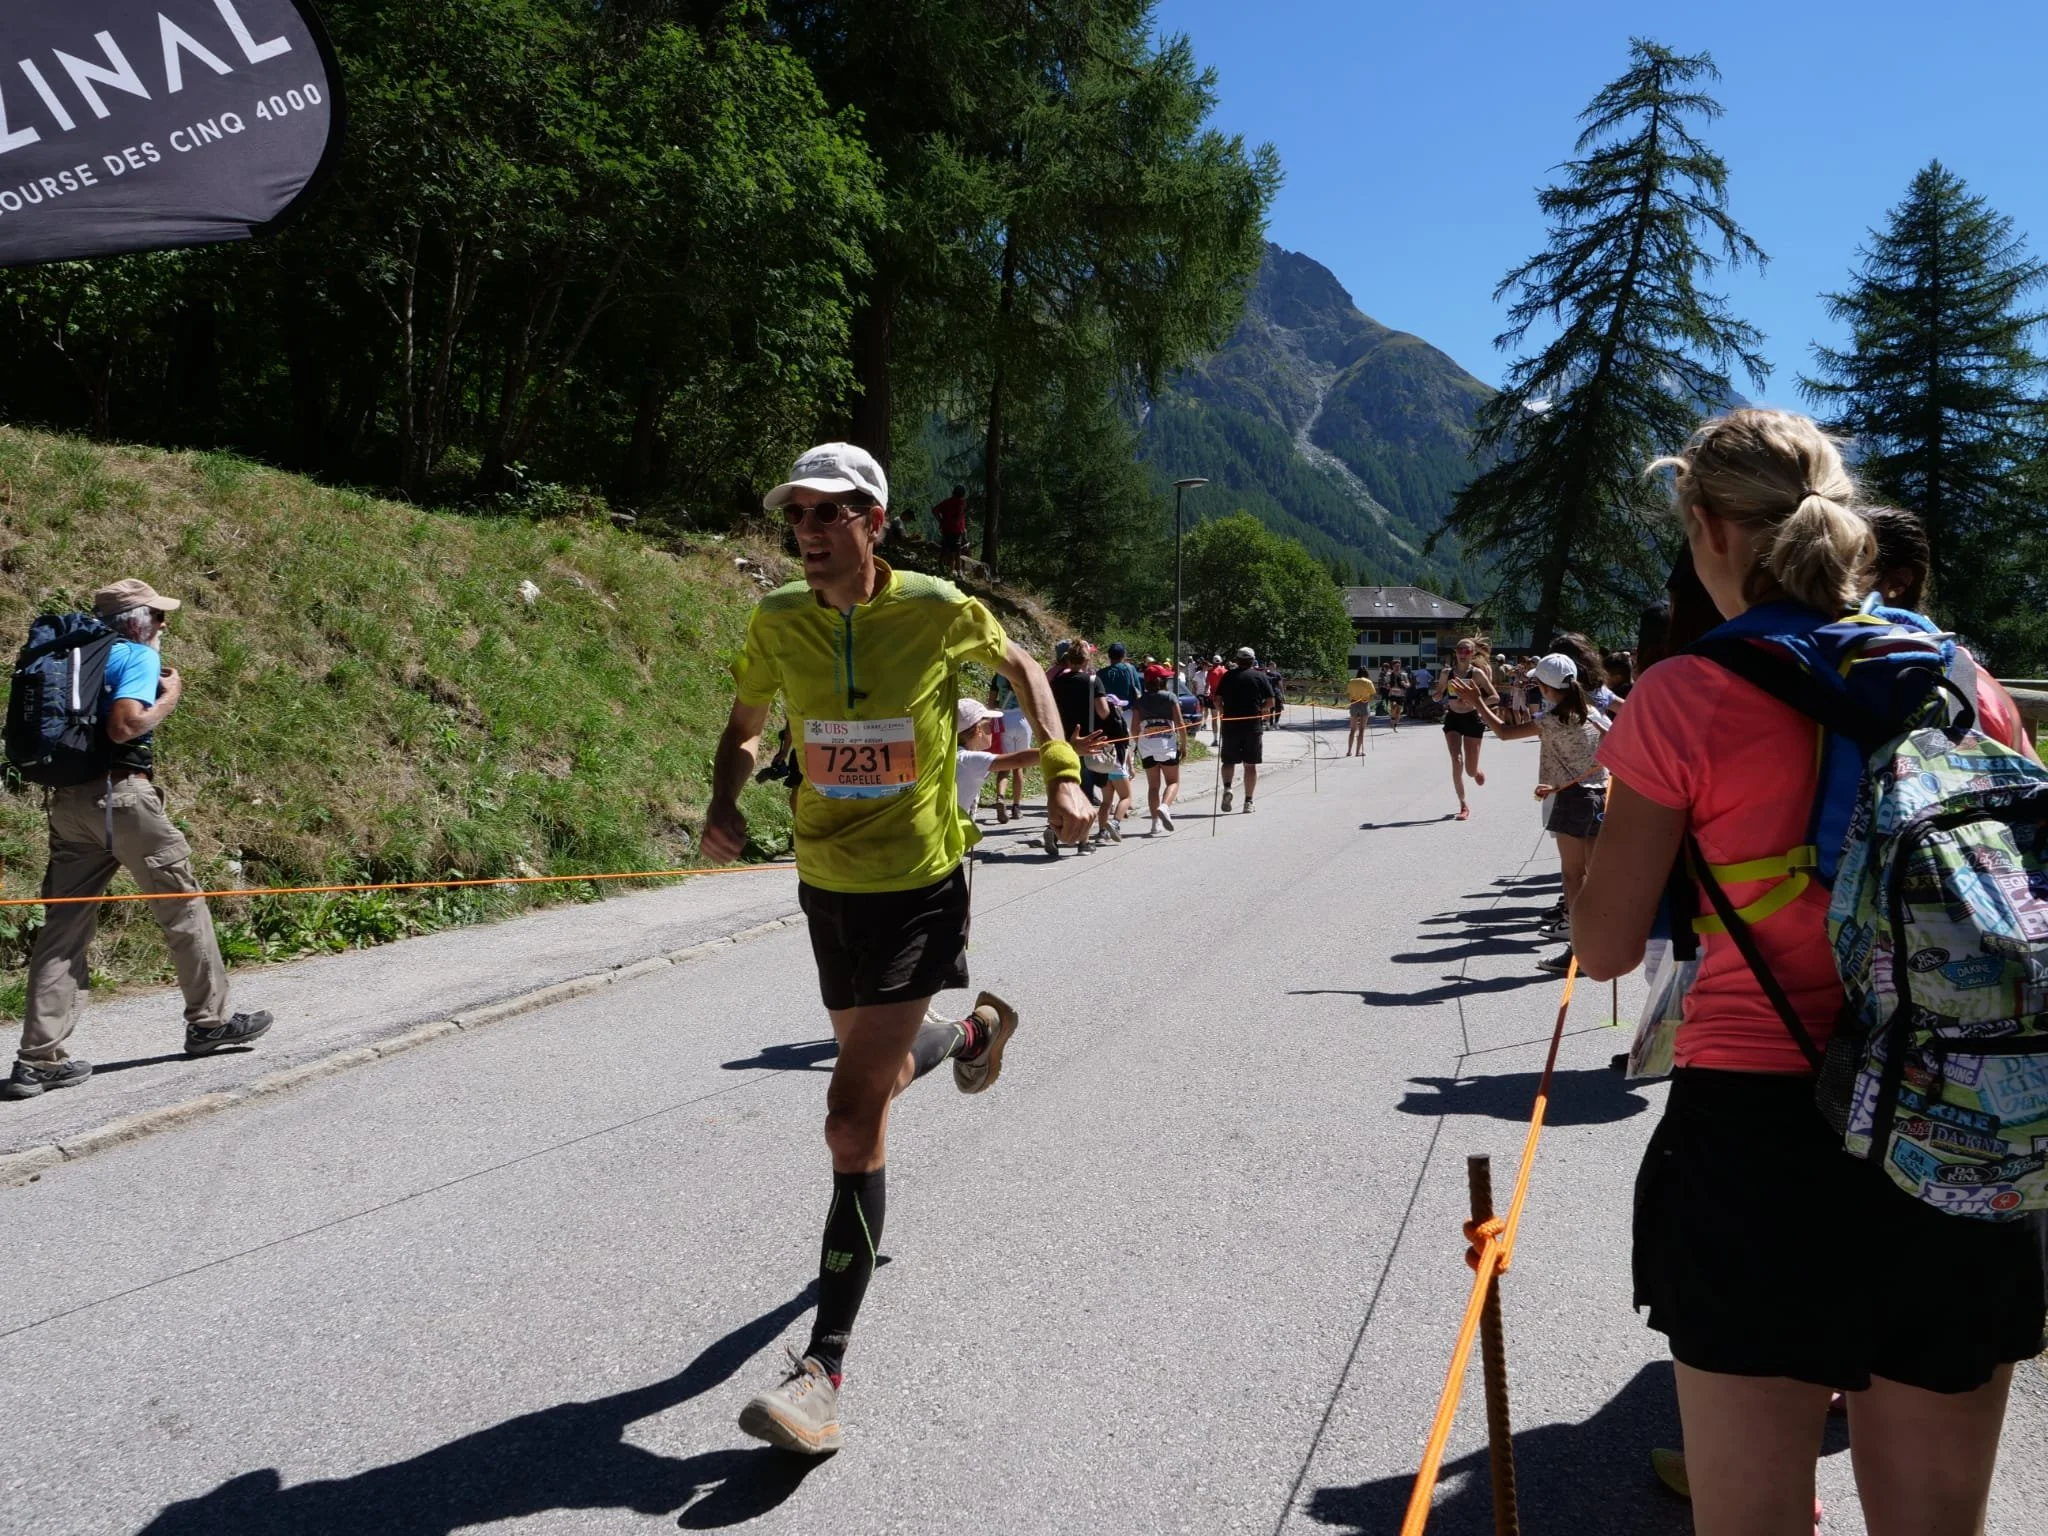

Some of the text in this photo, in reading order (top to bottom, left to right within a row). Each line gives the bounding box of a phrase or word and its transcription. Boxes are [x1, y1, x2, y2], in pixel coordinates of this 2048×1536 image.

[0, 82, 323, 217] OURSE DES CINQ 4000
[825, 723, 849, 735] UBS
[821, 744, 891, 773] 7231
[838, 774, 882, 785] CAPELLE
